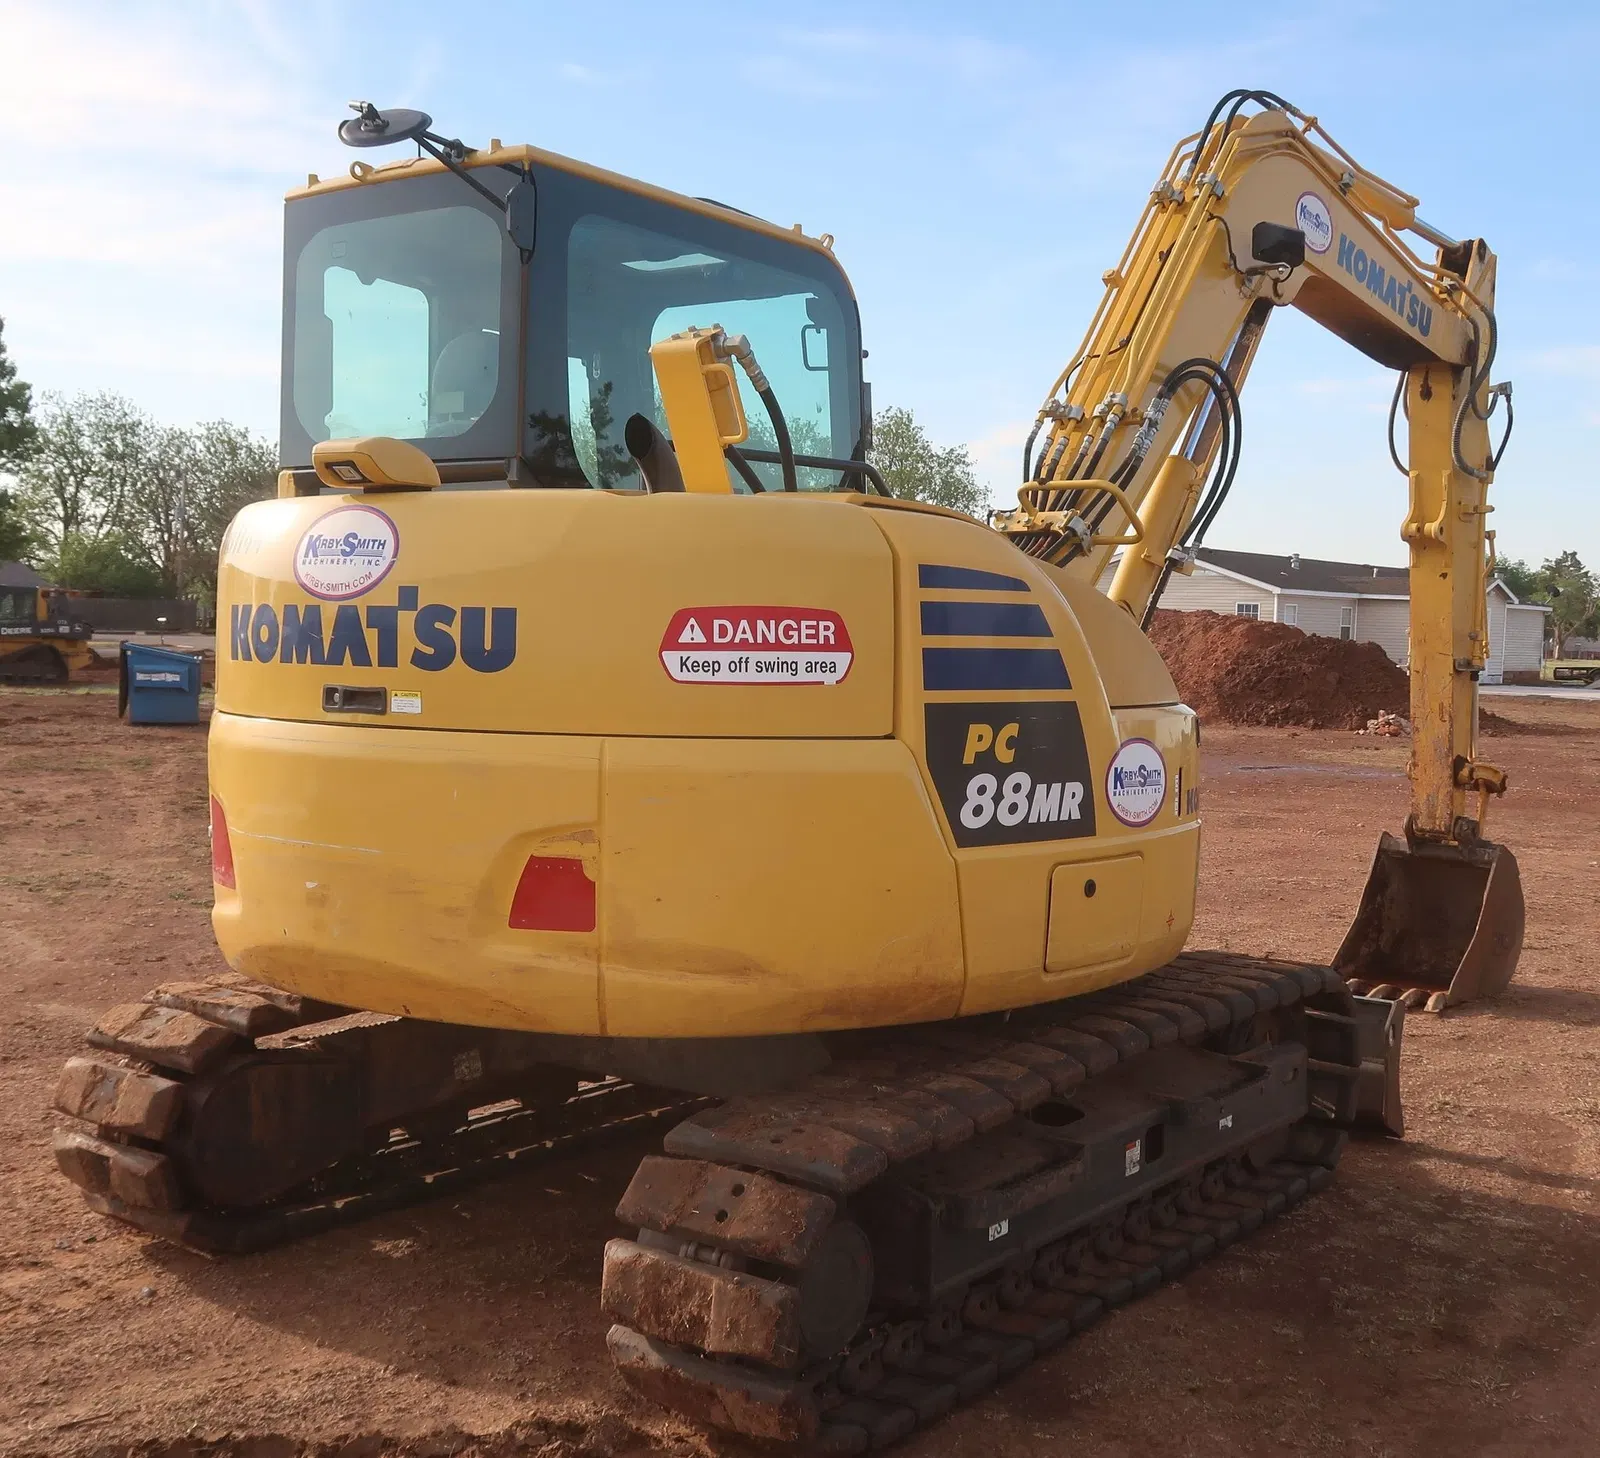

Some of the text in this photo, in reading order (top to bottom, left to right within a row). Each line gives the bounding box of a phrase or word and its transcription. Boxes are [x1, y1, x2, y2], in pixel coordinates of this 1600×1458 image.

[1337, 233, 1433, 337] KOMATSU
[303, 532, 387, 558] KIRBY-SMITH
[302, 558, 357, 567] MACHINERY,
[304, 571, 373, 593] KIRBY-SMITH.COM
[231, 586, 517, 673] KOMATSU
[713, 619, 835, 644] DANGER
[679, 656, 837, 677] Keep off swing area
[962, 723, 1019, 765] PC
[1113, 764, 1162, 790] KIRBY-SMITH
[959, 771, 1084, 829] 88MR
[1113, 788, 1150, 796] MACHINERY,
[1116, 799, 1159, 819] KIRBY-SMITH.COM
